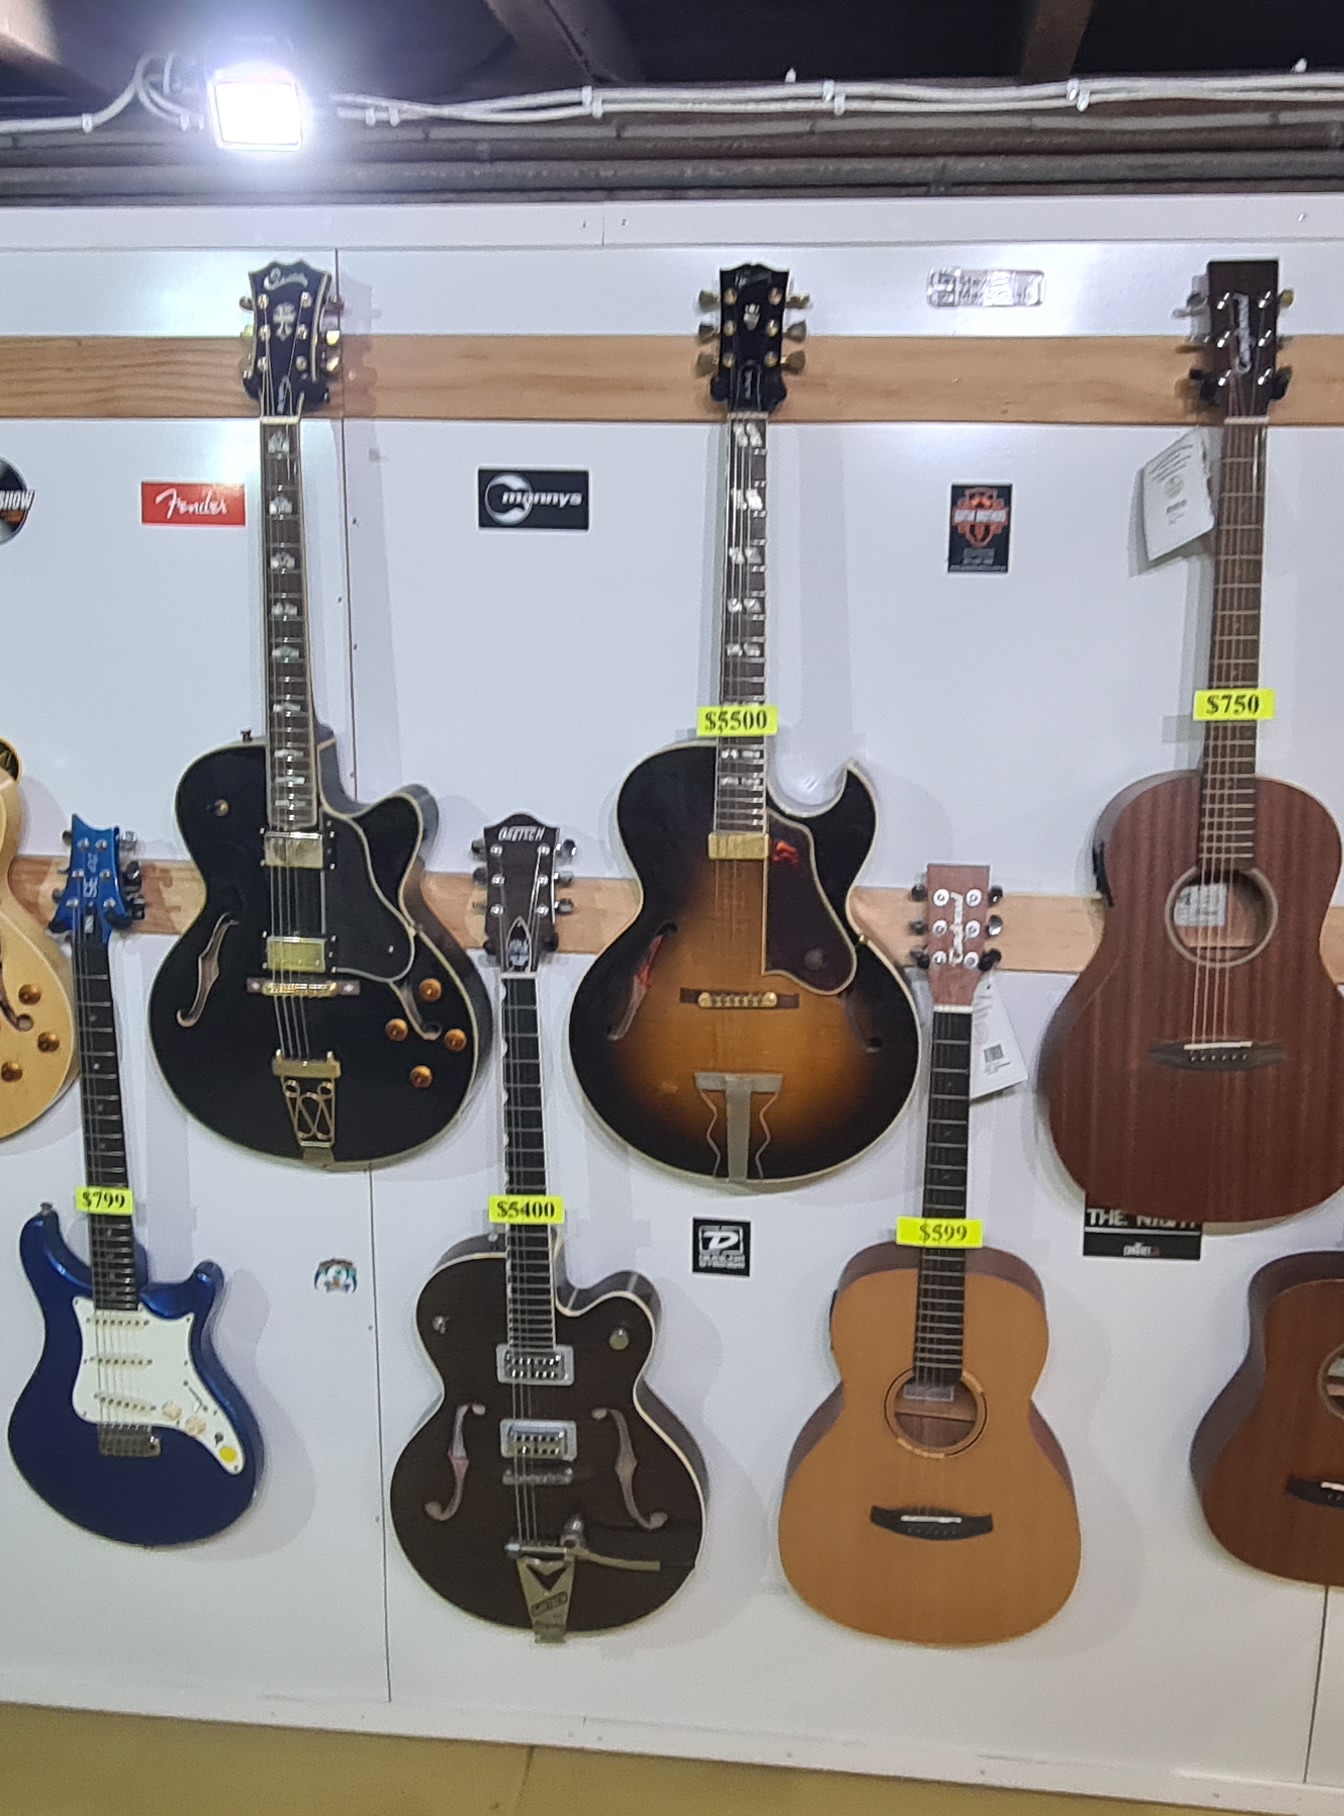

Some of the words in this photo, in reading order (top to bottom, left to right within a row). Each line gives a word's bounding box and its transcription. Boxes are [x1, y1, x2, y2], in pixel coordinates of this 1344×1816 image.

[155, 487, 227, 519] Fender
[1205, 694, 1261, 716] $750
[705, 709, 768, 734] $5500
[82, 1190, 126, 1210] $799
[496, 1200, 556, 1219] $5400
[1086, 1207, 1129, 1227] THE
[919, 1222, 968, 1244] $599
